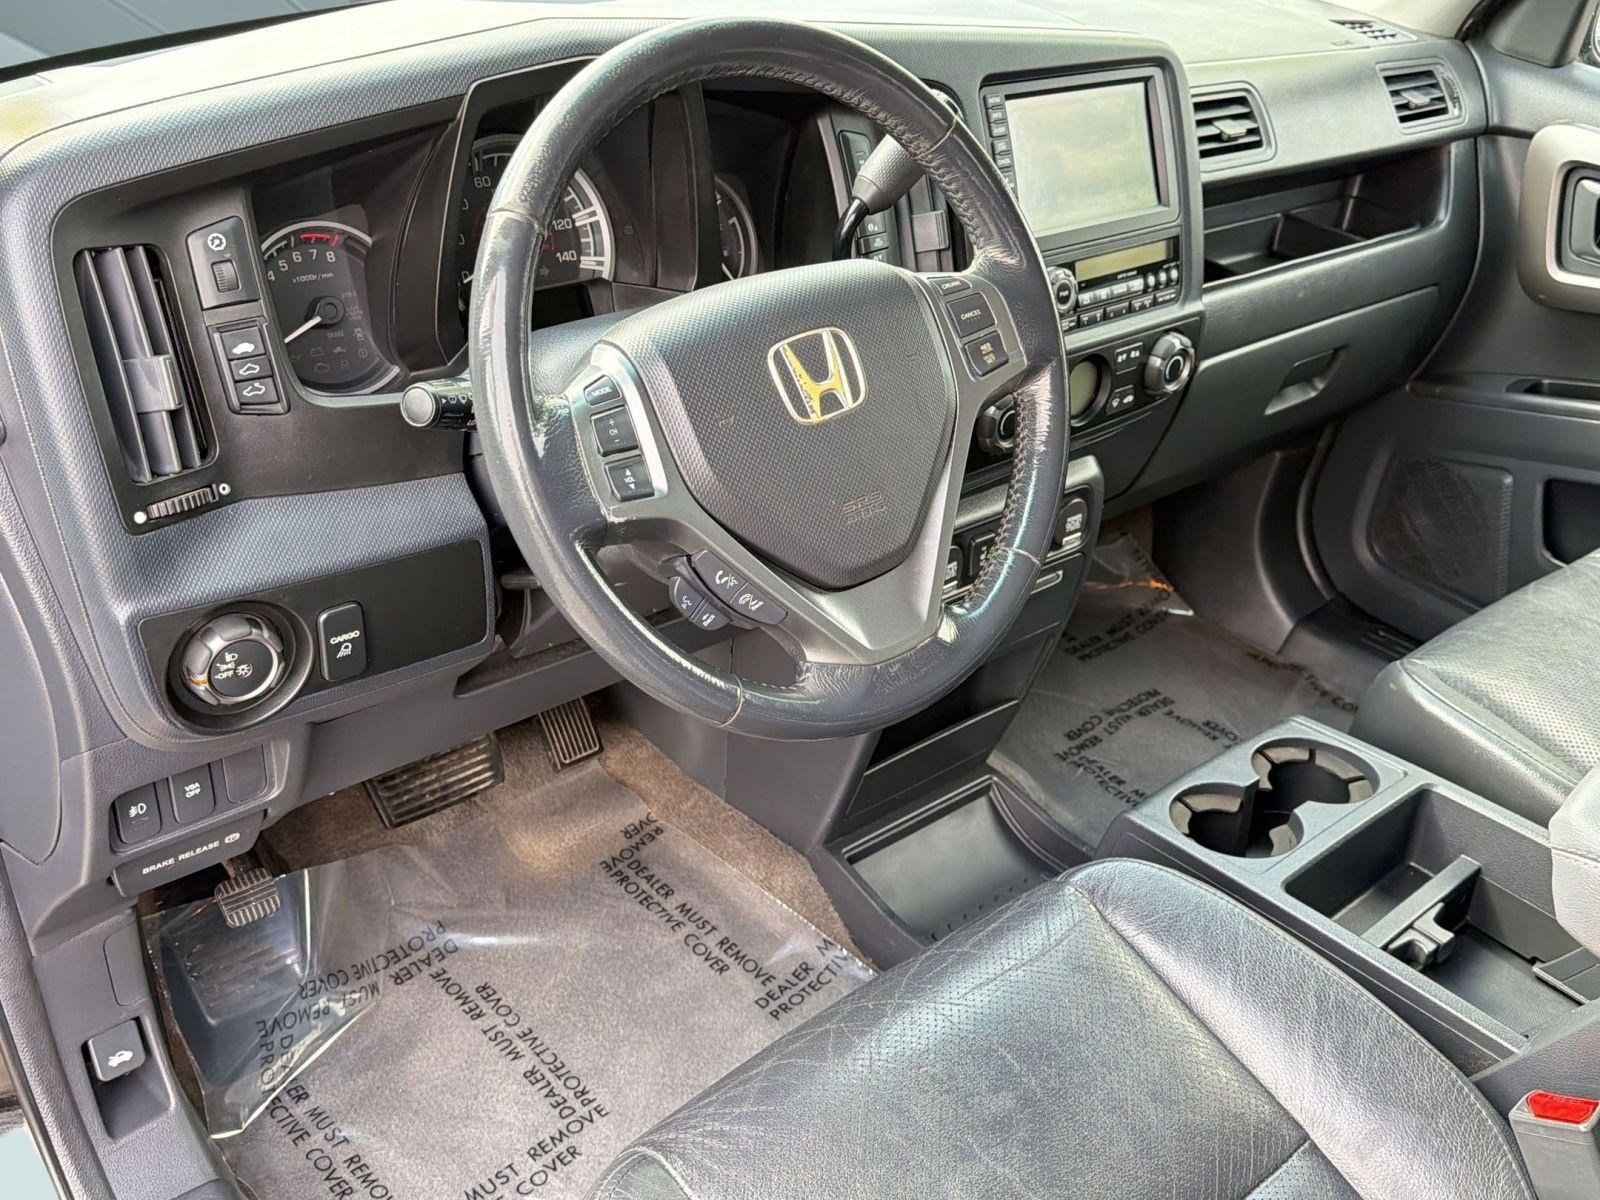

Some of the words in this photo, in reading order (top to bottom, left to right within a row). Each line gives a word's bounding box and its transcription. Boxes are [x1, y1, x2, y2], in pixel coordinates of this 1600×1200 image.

[474, 176, 491, 188] 60
[552, 218, 573, 231] 120
[278, 260, 288, 271] 5
[292, 251, 302, 262] 6
[309, 249, 317, 260] 7
[326, 251, 336, 262] 8
[555, 250, 577, 263] 140
[961, 309, 982, 320] CANCEL
[329, 630, 360, 645] CARGO
[1054, 735, 1103, 763] REMOVE
[1063, 715, 1103, 742] COVER
[184, 782, 200, 791] VSA
[1079, 755, 1127, 787] DEALER
[185, 788, 201, 798] OFF
[142, 857, 176, 875] BRAKE
[178, 840, 220, 862] RELEASE
[600, 826, 665, 873] REMOVE
[609, 869, 686, 933] PROTECTIVE
[684, 933, 730, 976] COVER
[627, 860, 675, 900] DEALER
[674, 902, 718, 936] MUST
[716, 936, 776, 987] REMOVE
[351, 920, 446, 980] PROTECTIVE
[389, 939, 460, 986] DEALER
[299, 969, 349, 1000] COVER
[430, 968, 486, 1021] REMOVE
[475, 981, 520, 1028] COVER
[755, 961, 815, 1009] DEALER
[481, 1024, 525, 1062] MUST
[516, 1027, 597, 1108] PROTECTIVE
[523, 1065, 577, 1120] DEALER
[304, 1106, 350, 1150] MUST
[526, 1104, 610, 1162] REMOVE
[305, 1148, 354, 1200] COVER
[516, 1145, 583, 1196] COVER
